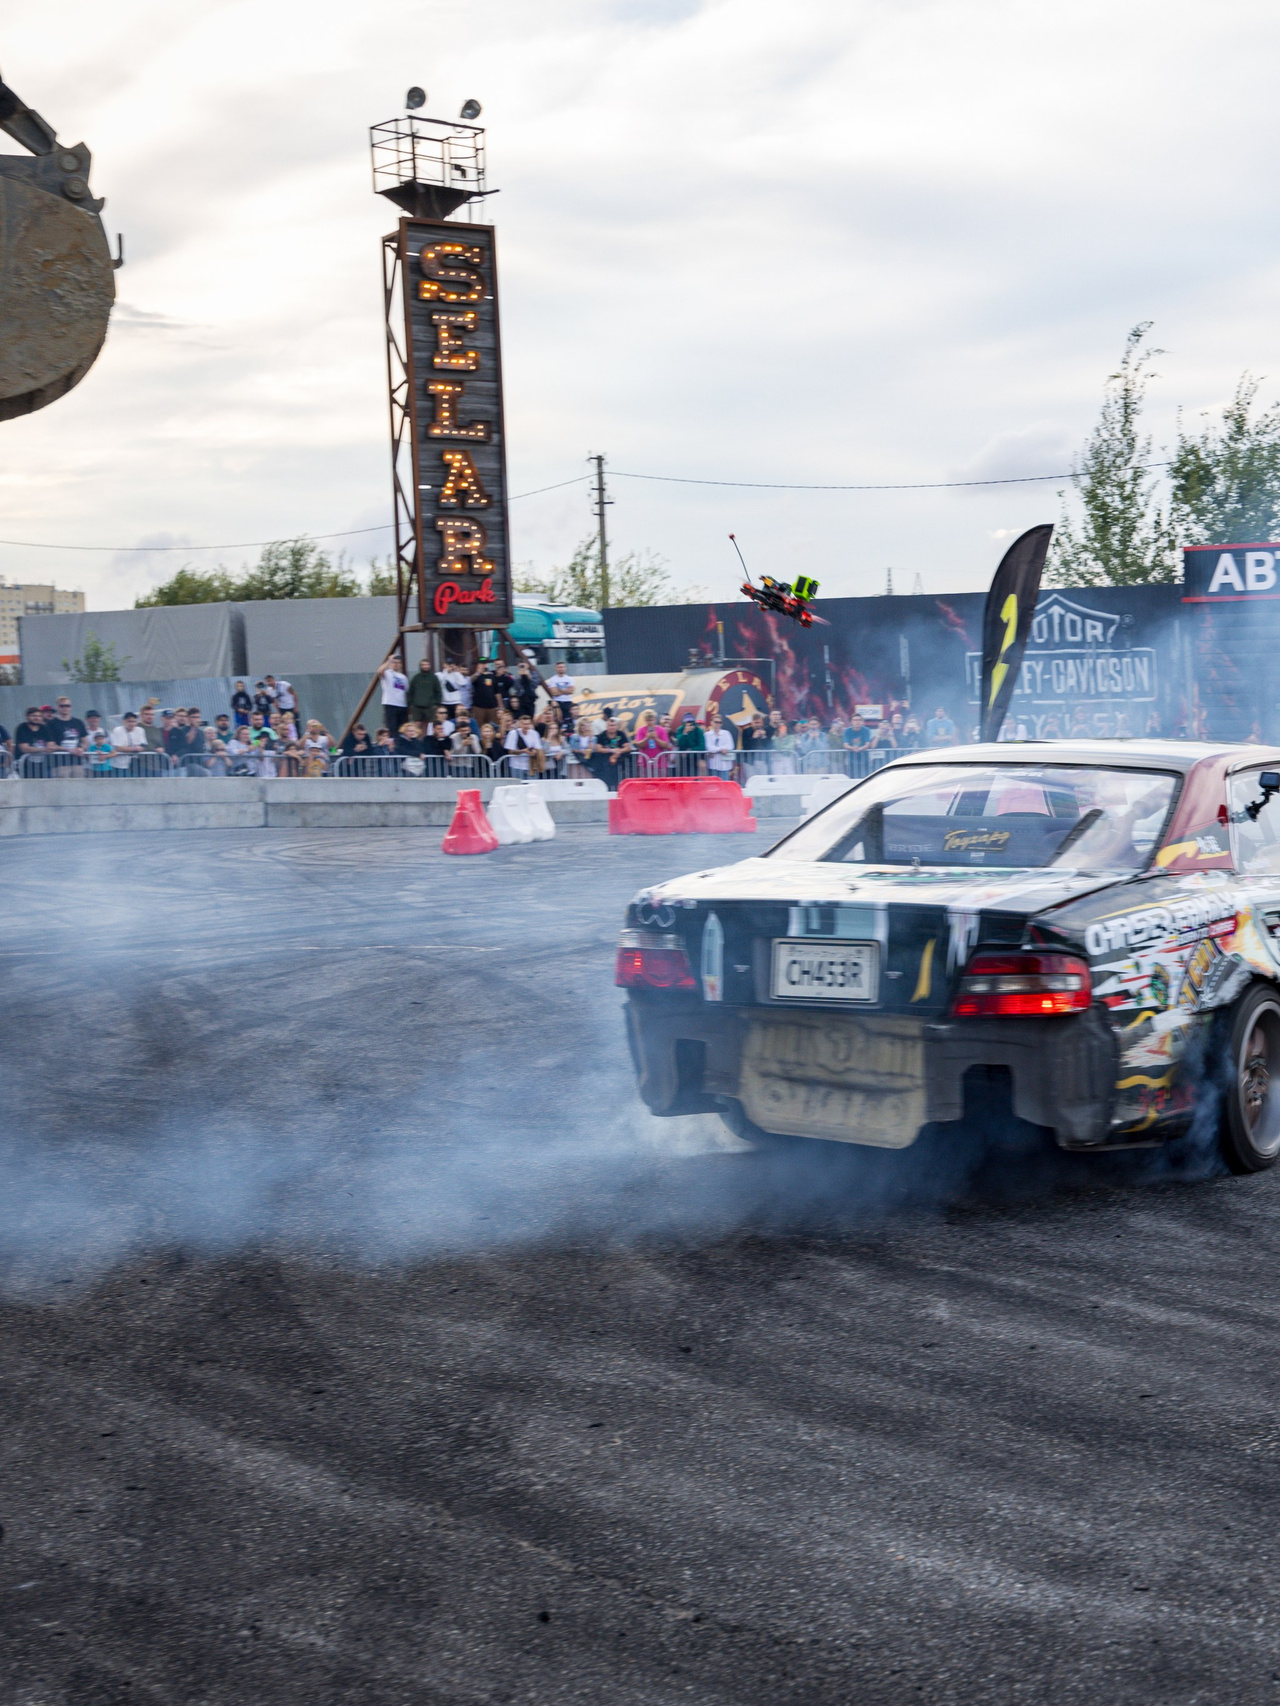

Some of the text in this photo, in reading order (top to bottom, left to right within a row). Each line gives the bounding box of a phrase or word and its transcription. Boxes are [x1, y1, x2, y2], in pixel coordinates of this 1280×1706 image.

[418, 240, 495, 576] SELAR
[434, 578, 498, 615] Park
[1026, 605, 1104, 643] OTOR
